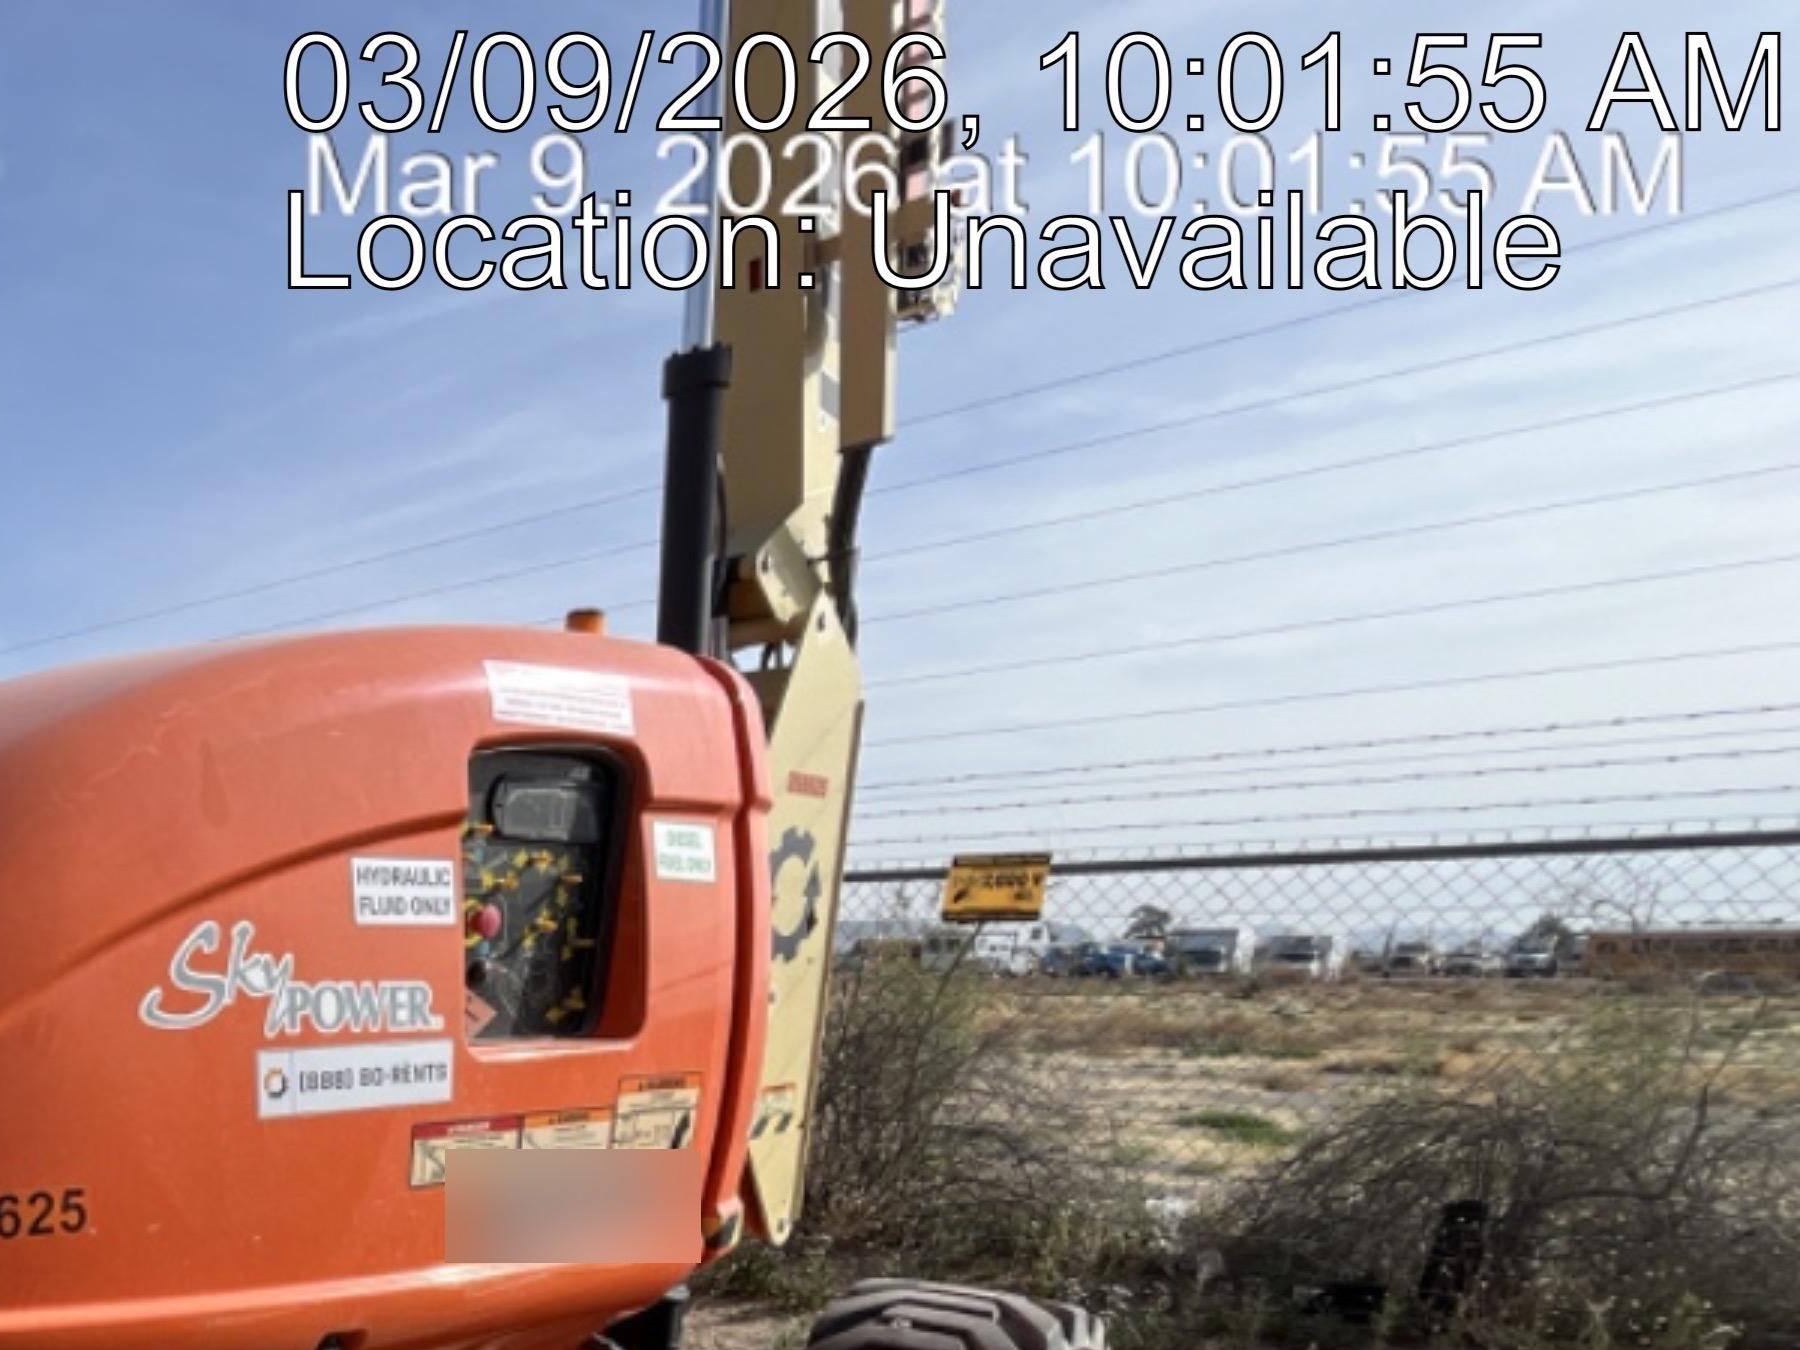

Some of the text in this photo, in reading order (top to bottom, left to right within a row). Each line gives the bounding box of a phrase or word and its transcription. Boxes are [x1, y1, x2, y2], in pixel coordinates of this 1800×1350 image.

[356, 866, 451, 887] HYDRAULIC
[359, 896, 451, 916] FLUID ONLY
[139, 920, 294, 1039] Sky
